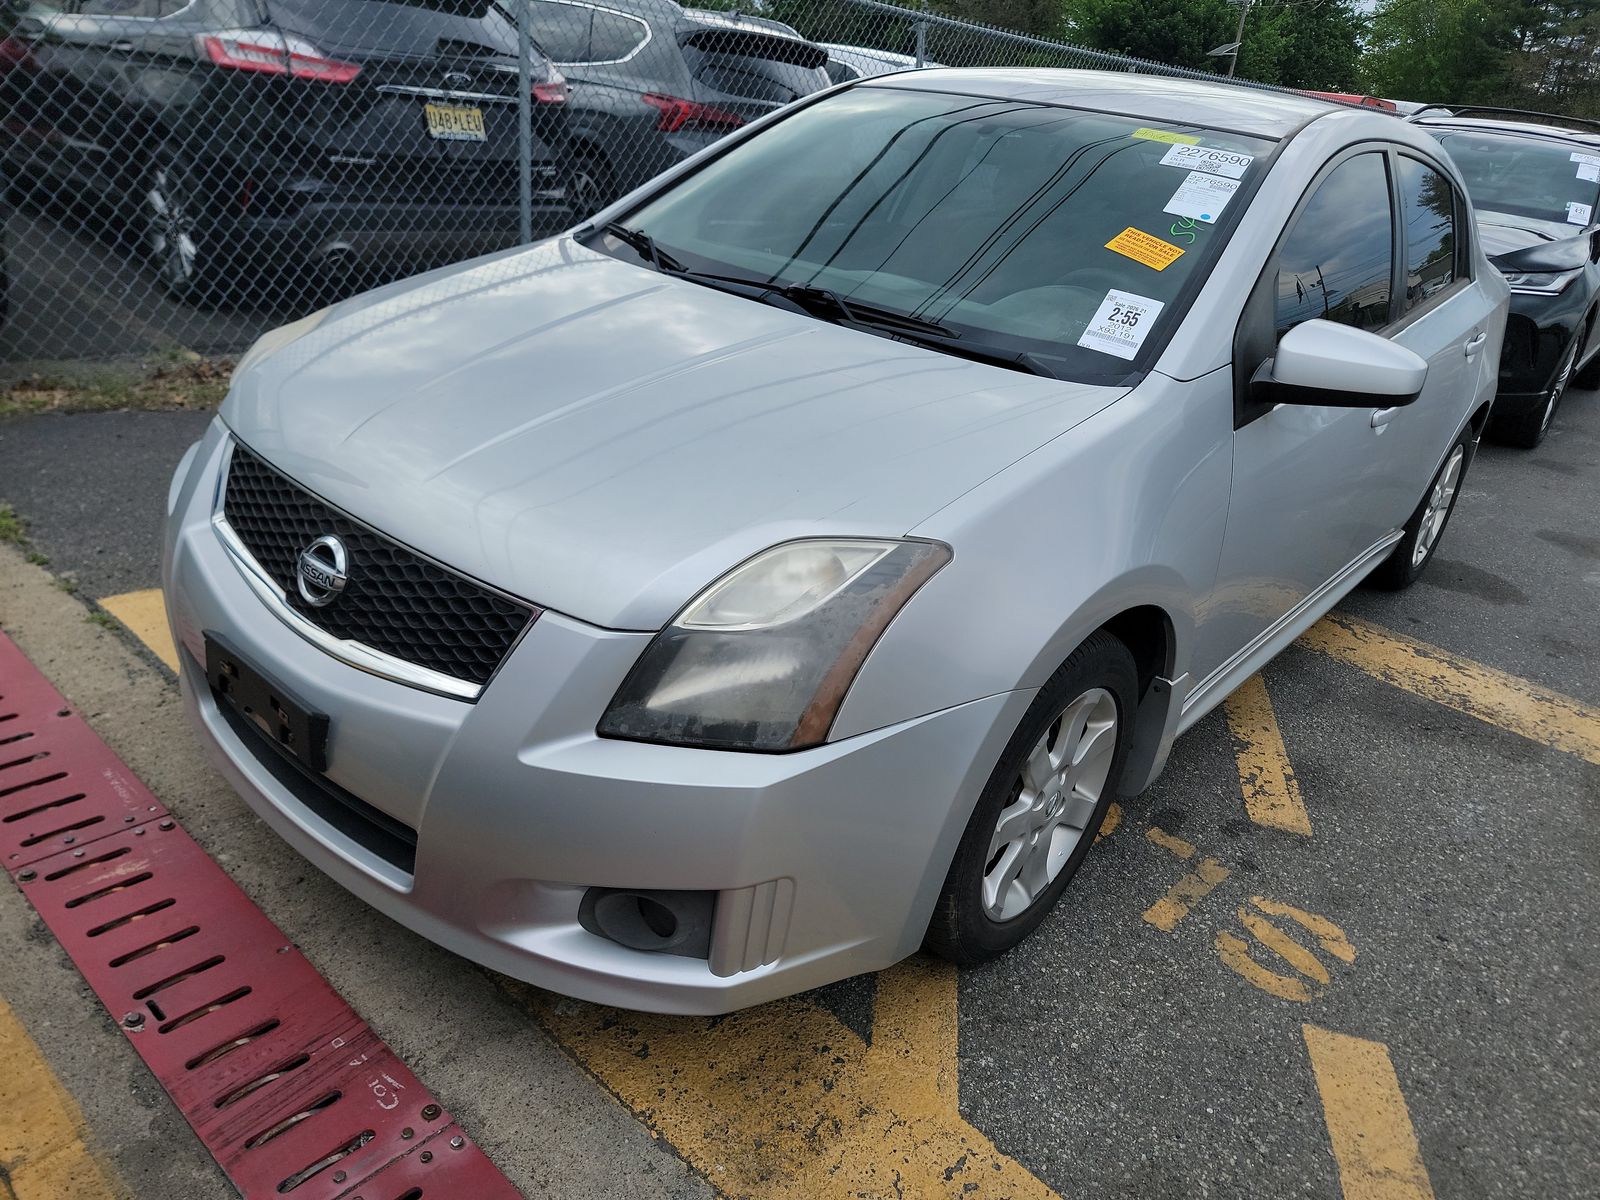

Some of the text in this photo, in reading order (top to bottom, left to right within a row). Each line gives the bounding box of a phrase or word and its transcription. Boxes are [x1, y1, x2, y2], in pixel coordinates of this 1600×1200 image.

[1177, 146, 1251, 166] 2276590
[1188, 174, 1238, 189] 2276590
[1124, 233, 1175, 257] READY FOR SALE
[1142, 235, 1168, 248] VEHICLE
[1168, 247, 1182, 255] NOT
[1107, 307, 1141, 327] 2:55
[1107, 322, 1132, 332] 2012
